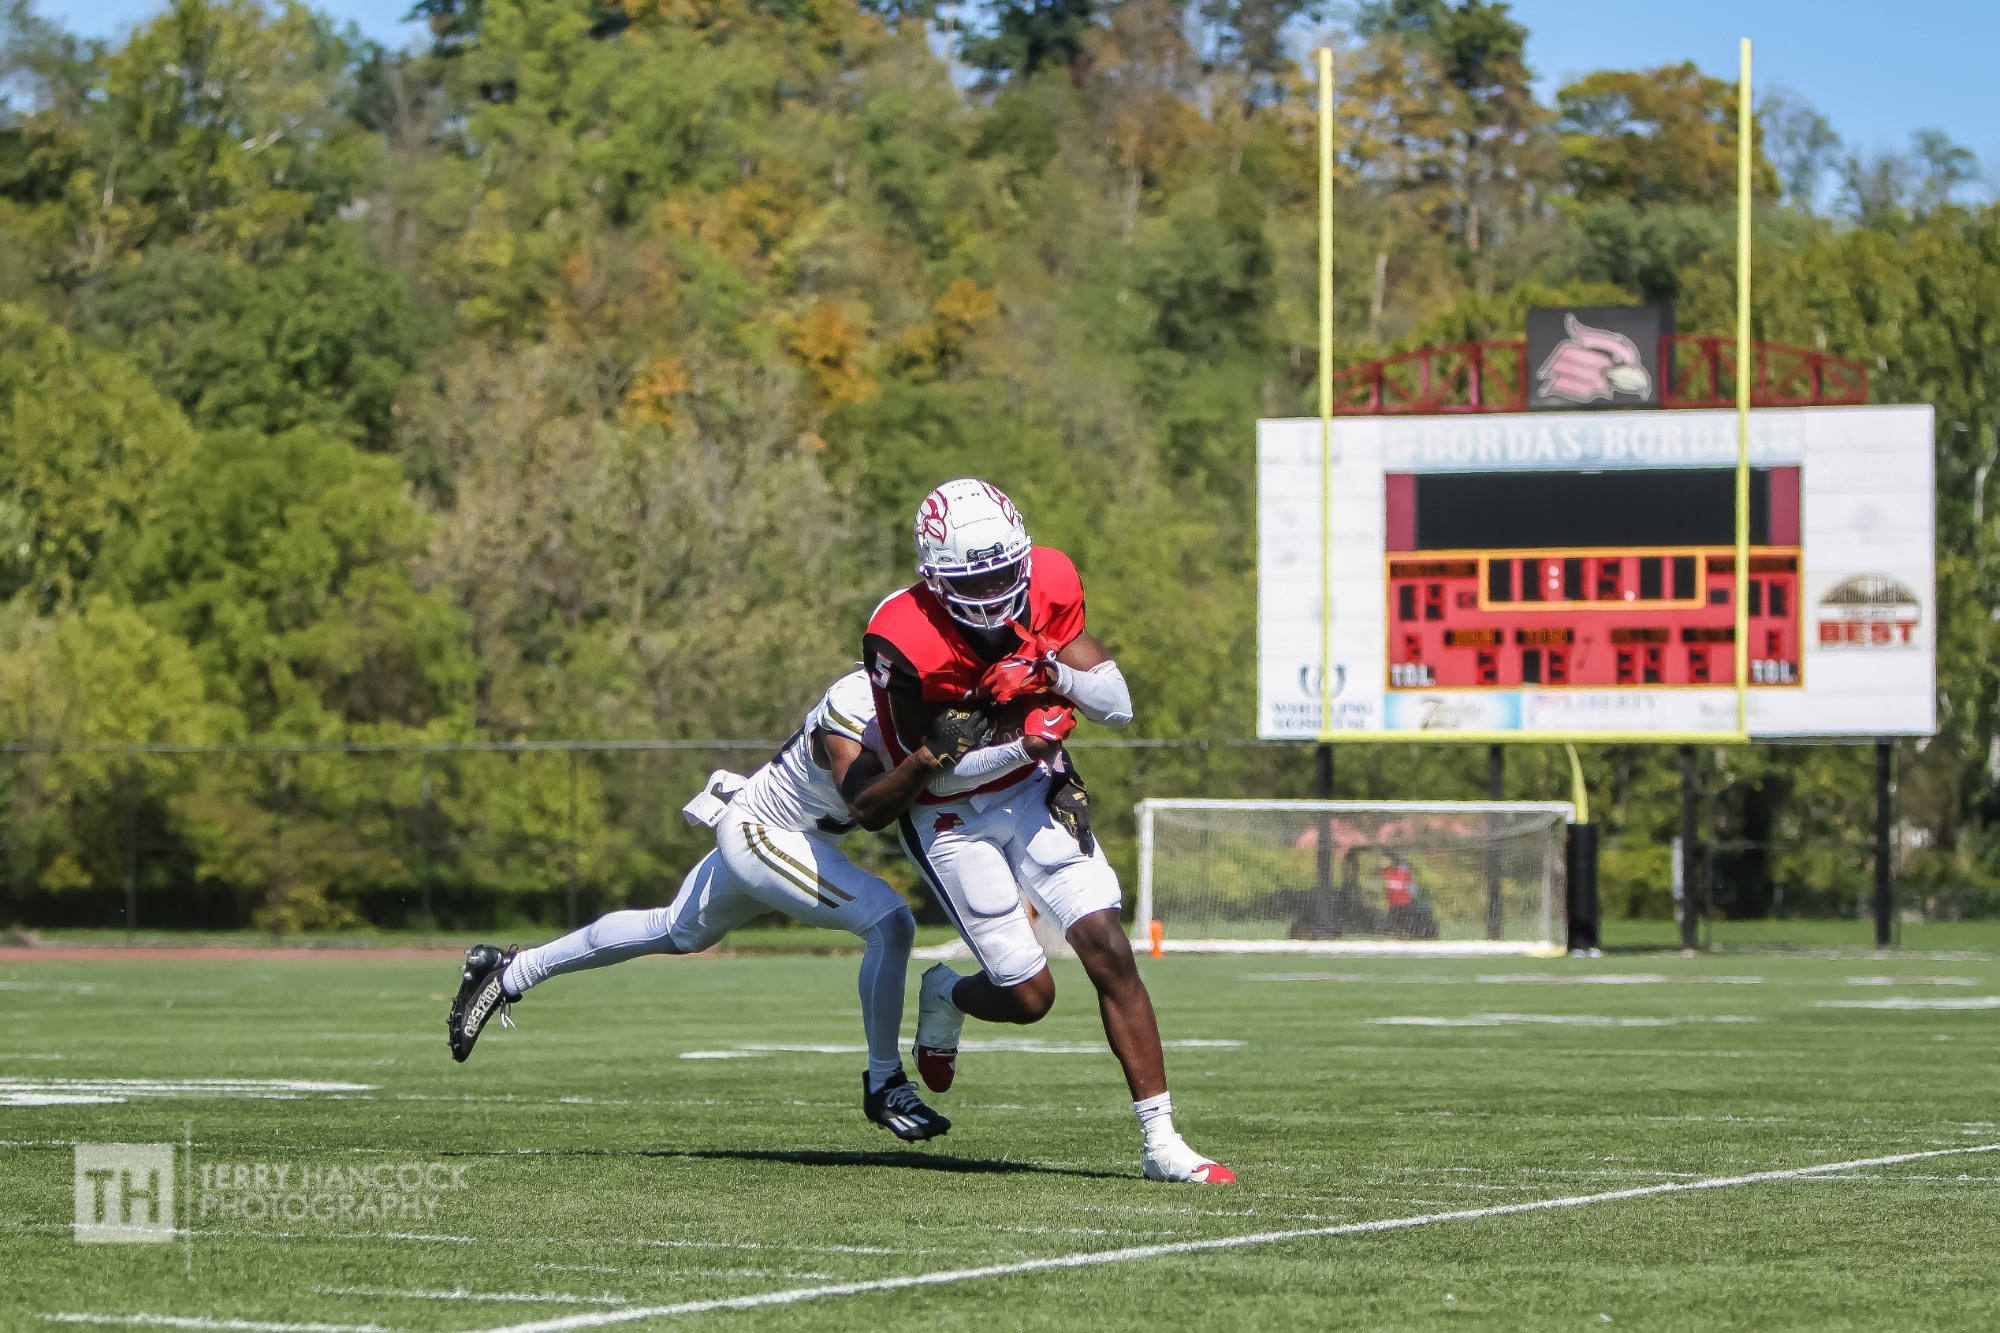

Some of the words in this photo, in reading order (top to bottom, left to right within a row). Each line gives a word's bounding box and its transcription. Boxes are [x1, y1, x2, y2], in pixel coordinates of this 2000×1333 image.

[1421, 425, 1582, 461] BORDAS
[1820, 620, 1918, 646] BEST
[872, 652, 892, 688] 5
